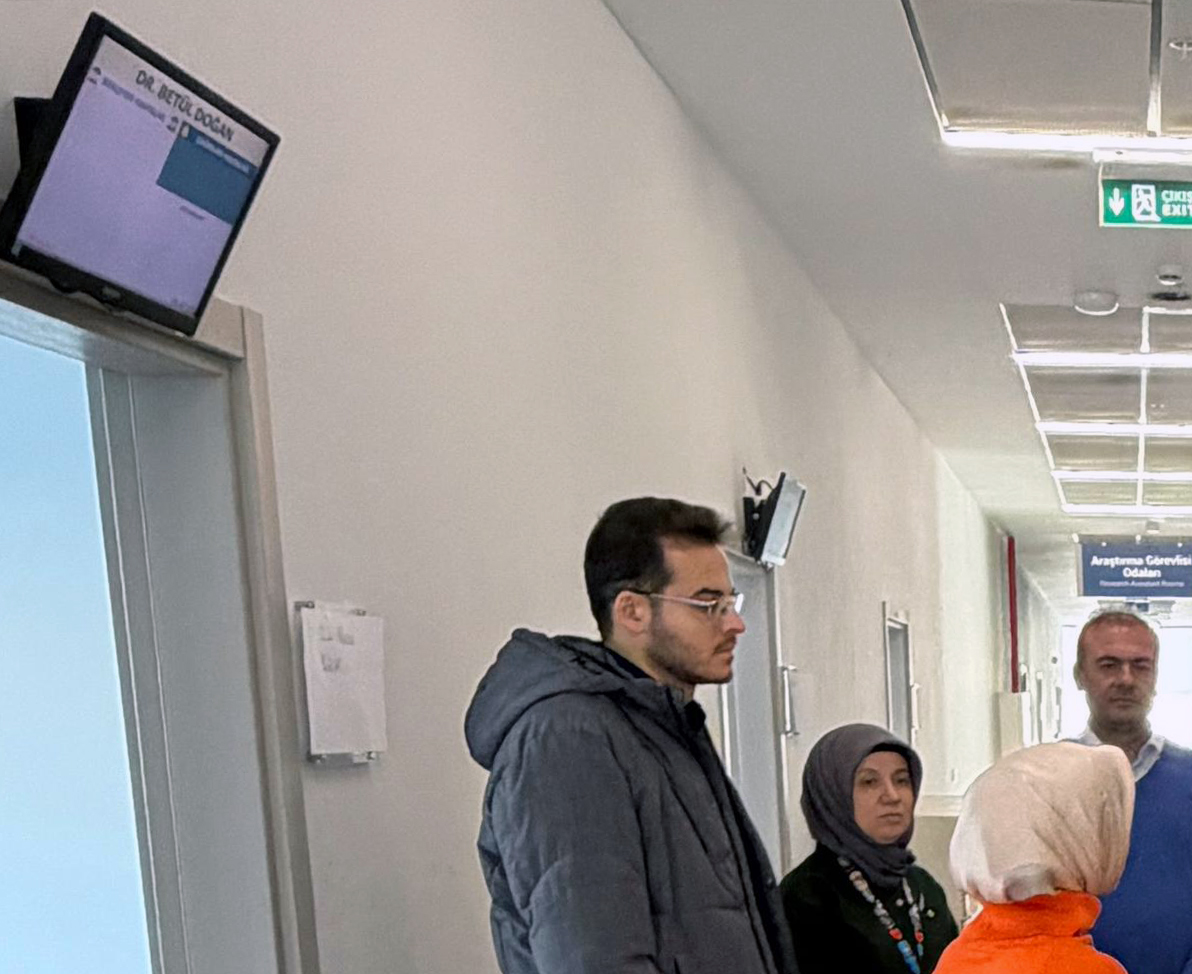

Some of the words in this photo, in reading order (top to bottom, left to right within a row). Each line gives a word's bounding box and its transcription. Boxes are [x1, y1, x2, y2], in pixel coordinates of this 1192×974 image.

[136, 70, 154, 93] DR.
[157, 83, 193, 117] BETÜL
[194, 107, 234, 142] DOĞAN
[1090, 555, 1144, 568] Araştırma
[1145, 554, 1192, 566] Görevlisi
